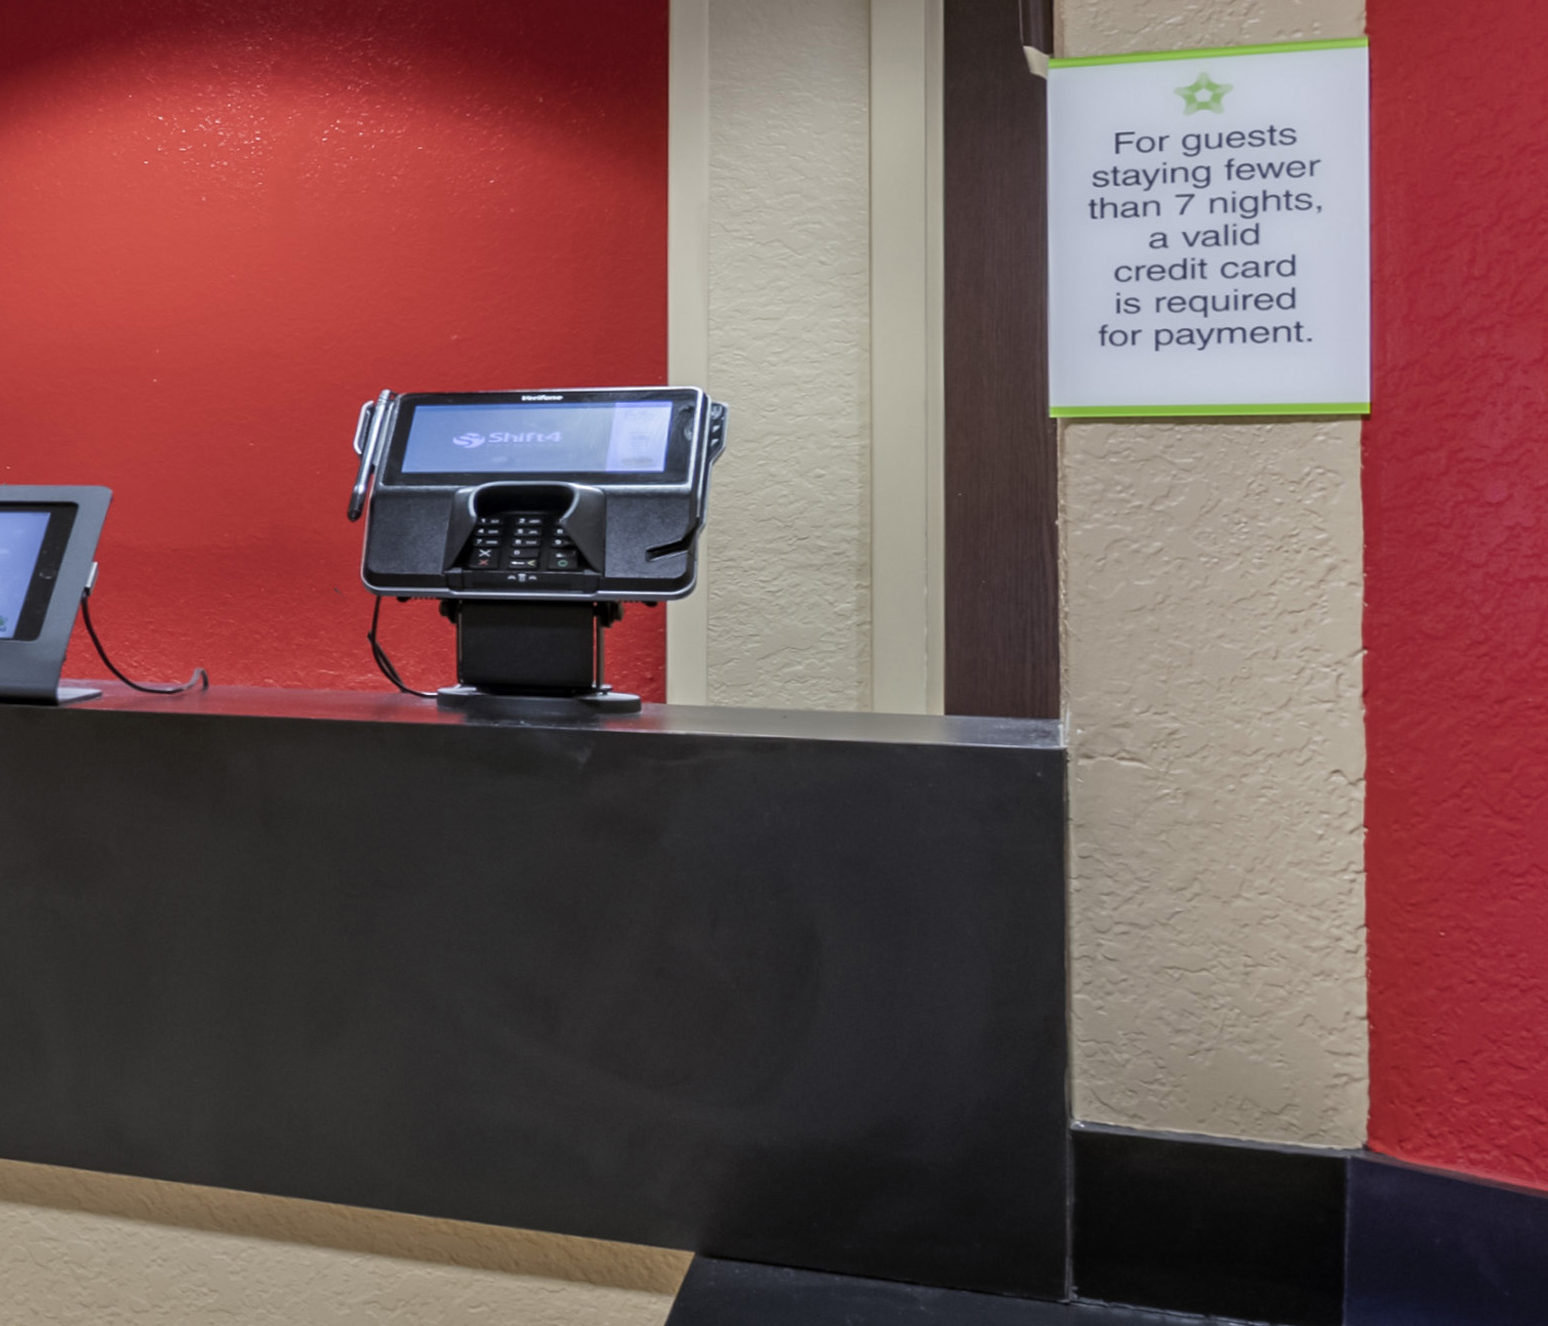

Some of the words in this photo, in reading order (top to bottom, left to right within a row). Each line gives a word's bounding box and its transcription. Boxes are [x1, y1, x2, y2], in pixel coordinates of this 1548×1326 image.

[1113, 131, 1170, 155] For
[1181, 125, 1298, 157] guests
[1091, 161, 1211, 192] staying
[1224, 158, 1321, 182] fewer
[1088, 197, 1161, 220] than
[1176, 194, 1196, 216] 7
[1208, 190, 1323, 220] nights,
[1148, 231, 1169, 249] a
[1182, 223, 1260, 248] valid
[1113, 258, 1208, 283] credit
[1219, 254, 1297, 280] card
[1115, 292, 1141, 315] is
[1155, 287, 1297, 318] required
[1098, 324, 1142, 347] for
[1154, 320, 1313, 352] payment.
[488, 431, 562, 443] Shift4
